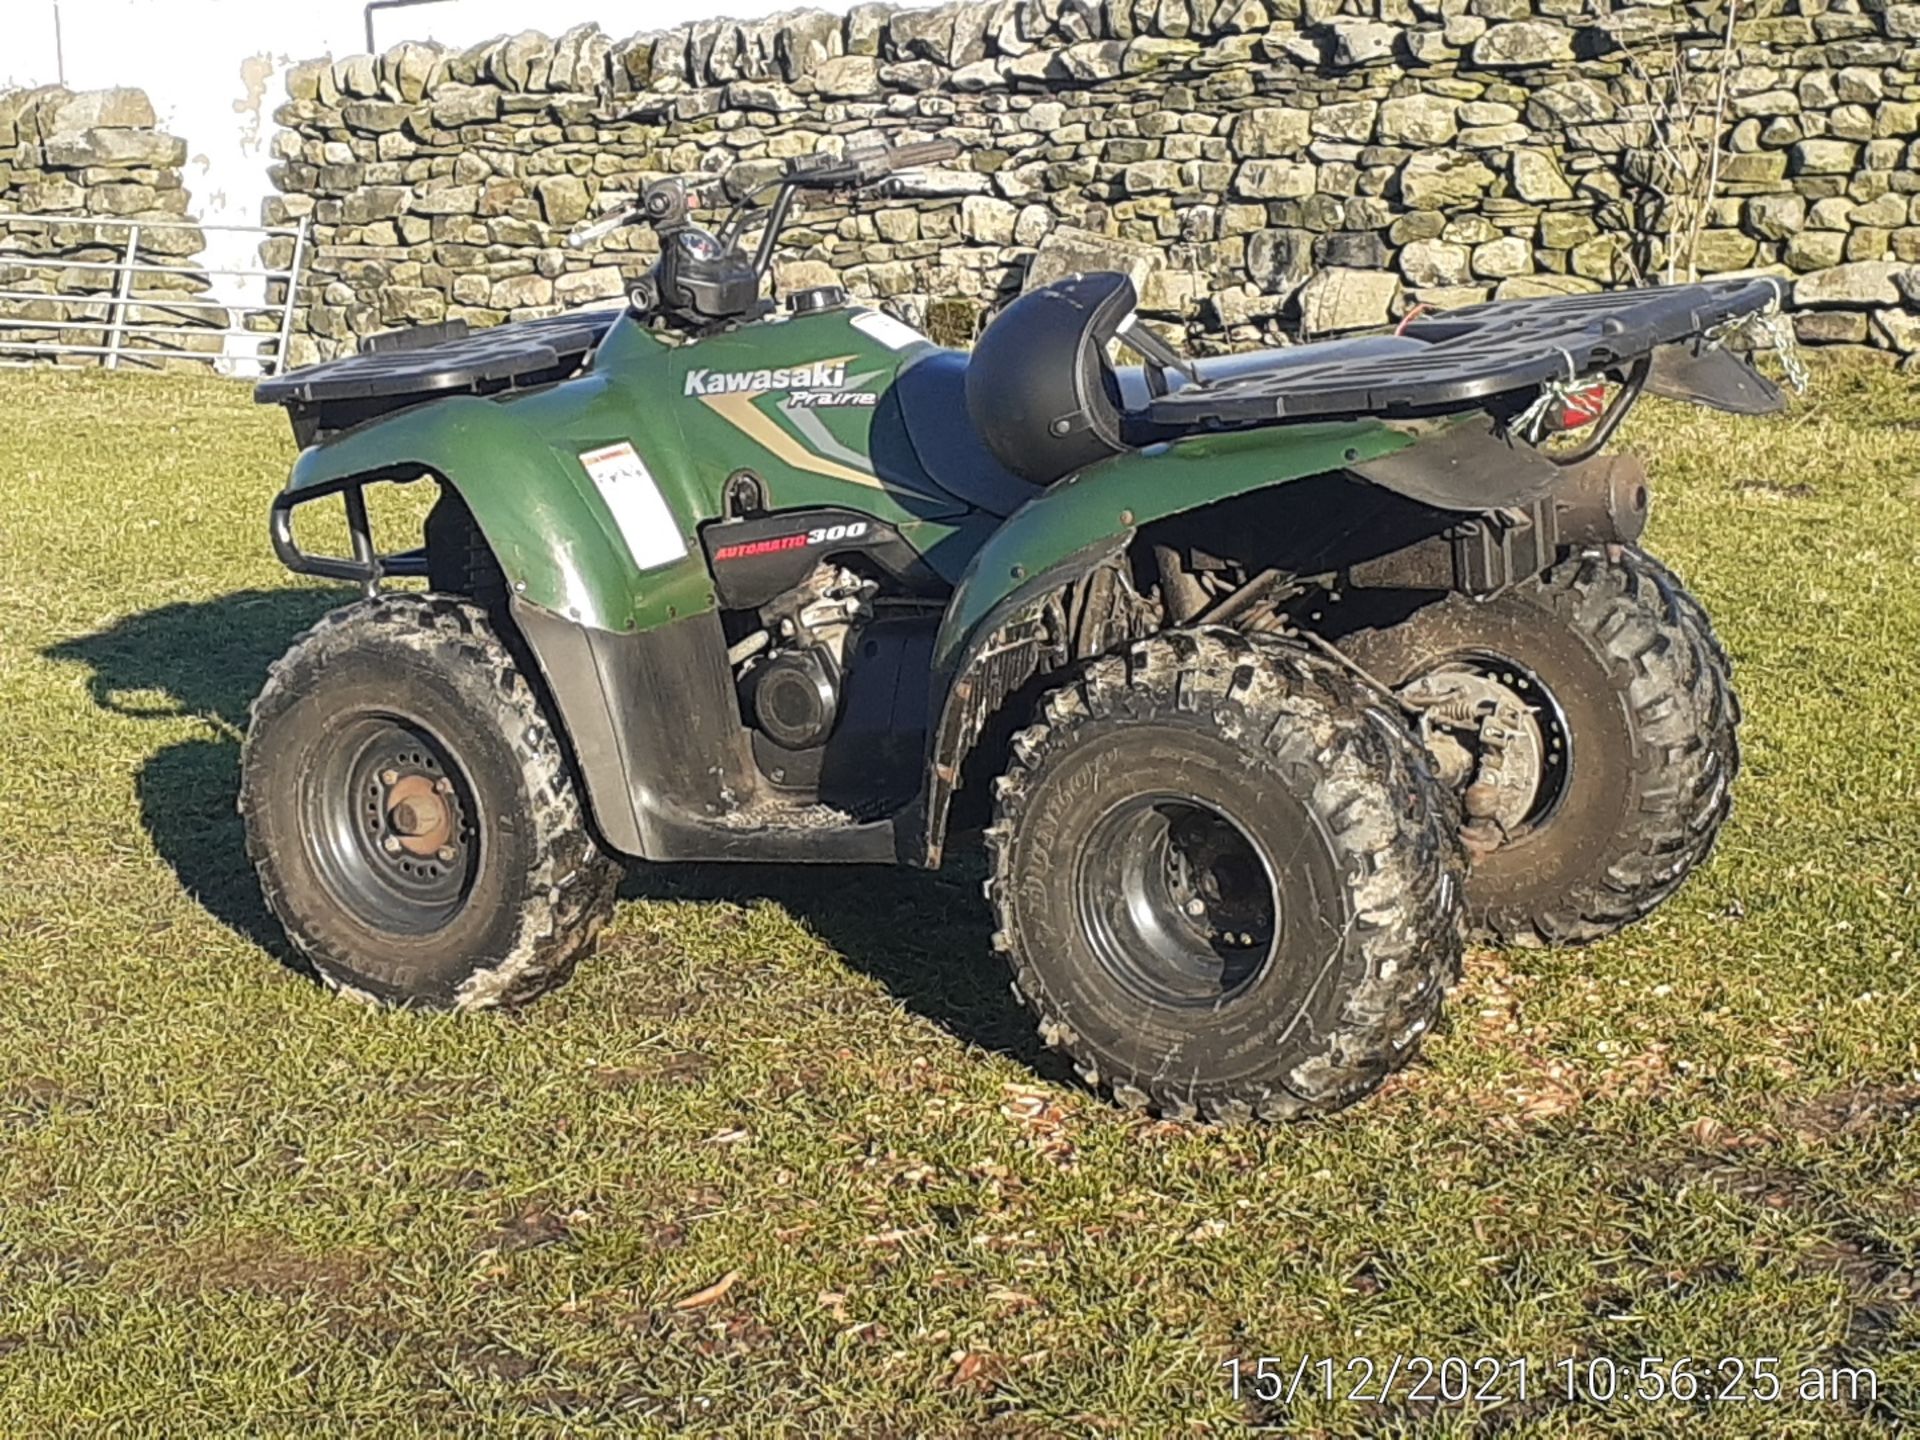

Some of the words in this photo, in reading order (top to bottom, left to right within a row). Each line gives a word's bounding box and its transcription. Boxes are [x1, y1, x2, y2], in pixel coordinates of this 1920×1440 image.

[685, 361, 846, 396] Kawasaki
[788, 390, 877, 407] Prairie
[716, 534, 807, 560] AUTOMATIC
[806, 522, 867, 544] 300
